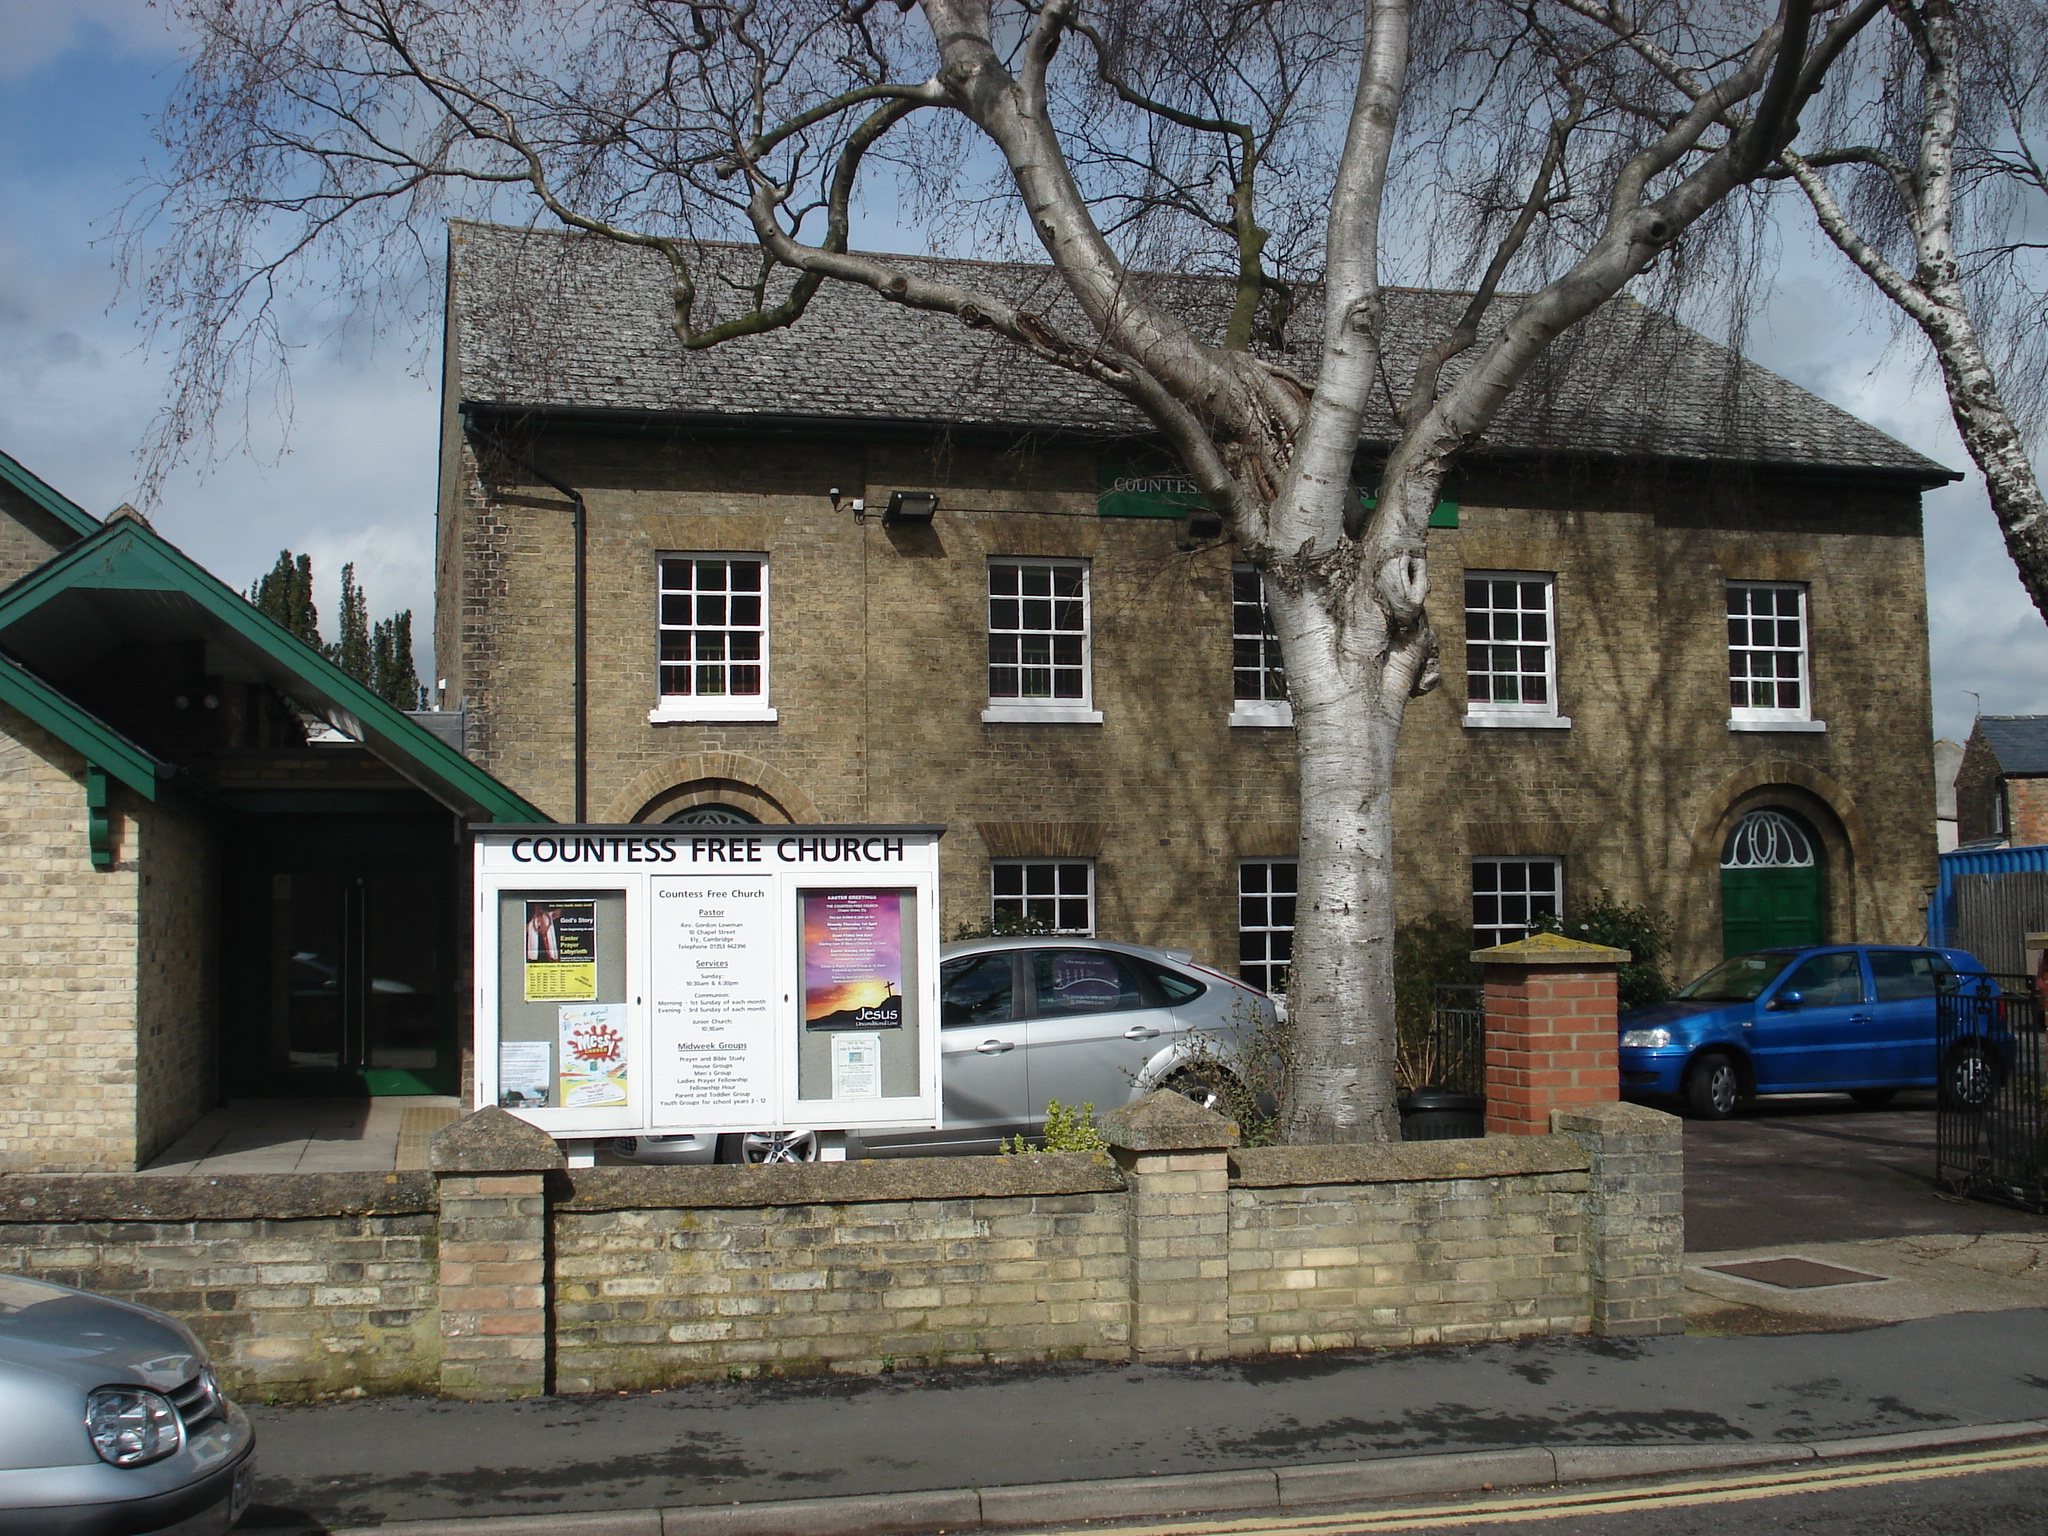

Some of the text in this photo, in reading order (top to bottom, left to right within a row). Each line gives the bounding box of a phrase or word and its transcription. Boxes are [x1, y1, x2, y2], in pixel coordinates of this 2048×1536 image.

[1114, 477, 1202, 494] COUNTES
[512, 838, 903, 862] COUNTESS FREE CHURCH
[659, 889, 764, 898] Countess Free Church
[590, 1006, 608, 1016] and
[856, 1008, 898, 1020] Jesus
[596, 1016, 607, 1024] for
[577, 1034, 616, 1056] Messy
